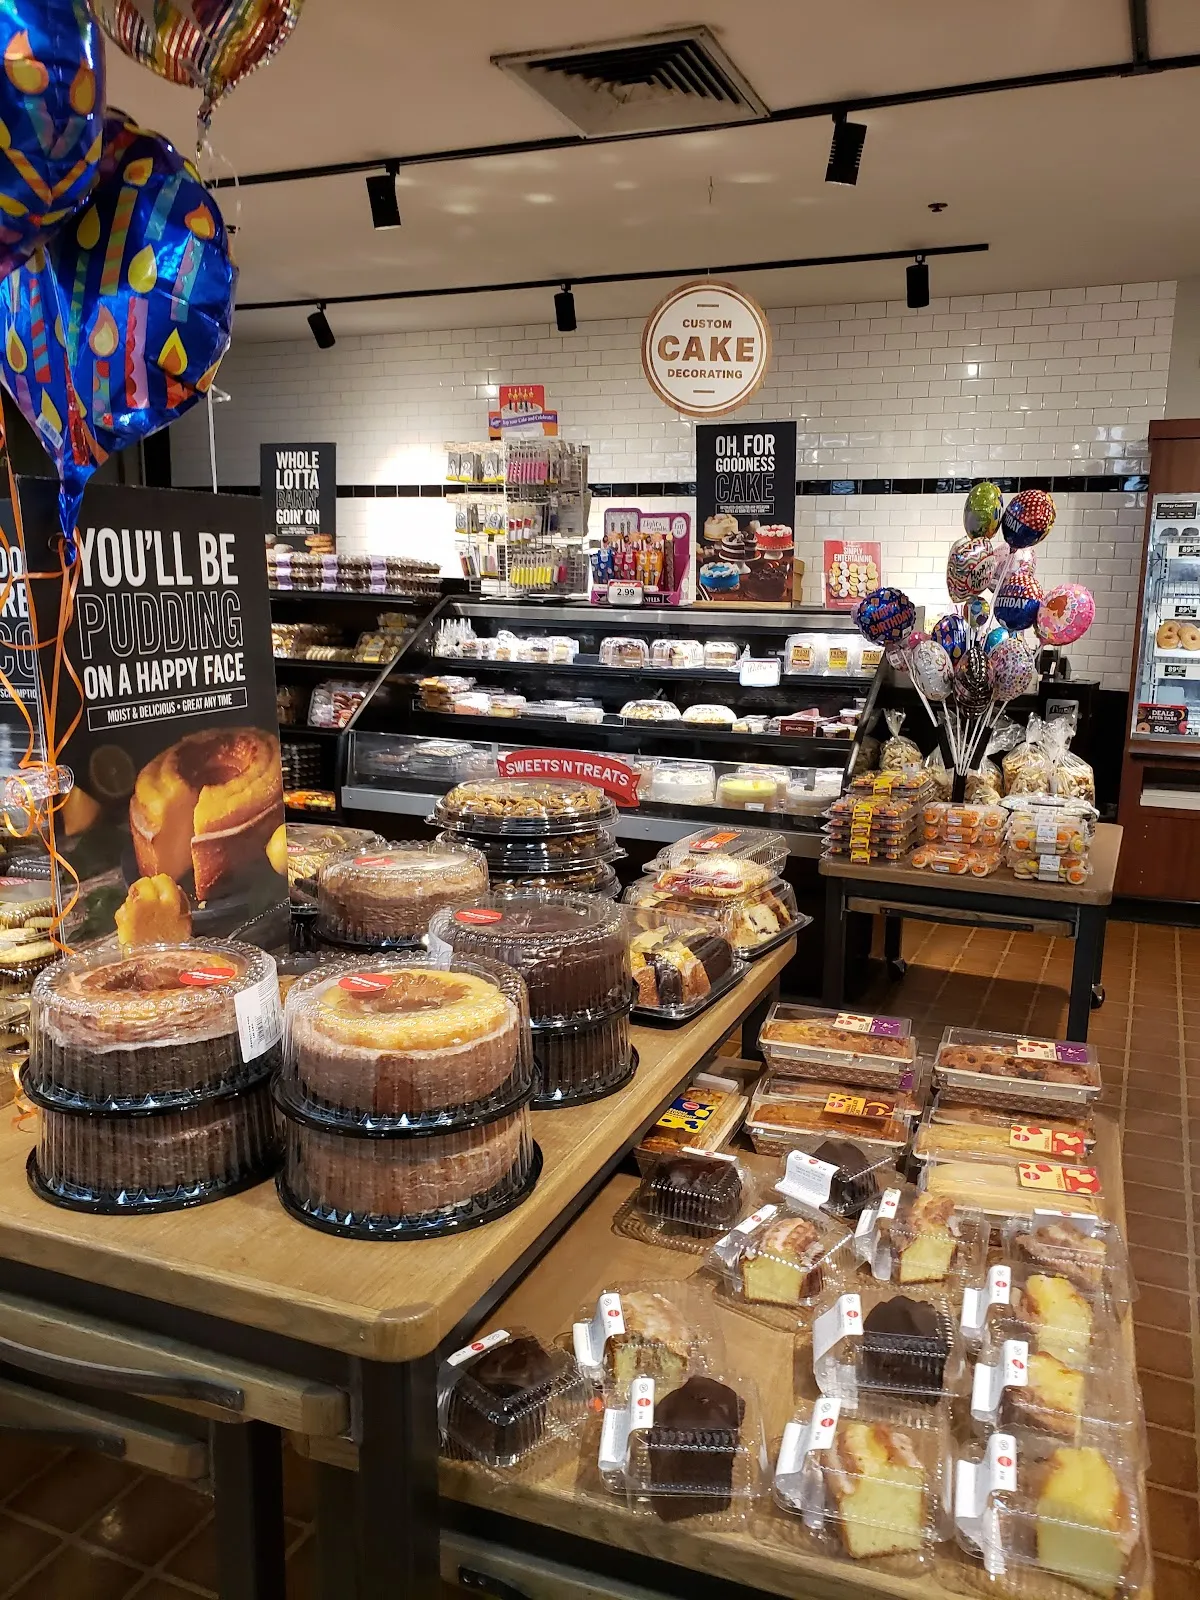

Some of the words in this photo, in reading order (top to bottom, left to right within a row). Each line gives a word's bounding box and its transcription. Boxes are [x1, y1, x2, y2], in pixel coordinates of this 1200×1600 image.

[682, 319, 732, 329] CUSTOM
[657, 335, 755, 362] CAKE
[667, 369, 743, 379] DECORATING
[715, 435, 740, 457] OH,
[743, 434, 776, 456] FOR
[275, 451, 320, 469] WHOLE
[715, 456, 776, 473] GOODNESS
[275, 469, 320, 490] LOTTA
[715, 472, 775, 503] CAKE
[275, 489, 320, 509] BAKIN'
[275, 509, 303, 525] GOIN'
[305, 509, 320, 525] ON
[79, 528, 194, 587] YOU'LL
[199, 532, 239, 585] BE
[833, 554, 873, 563] ENTERTAINING
[843, 546, 863, 555] SIMPLY
[616, 588, 635, 596] 2.99
[871, 600, 899, 621] HAPPY
[77, 590, 244, 660] PUDDING
[870, 608, 912, 635] BIRTHDAY
[84, 664, 114, 700] ON
[118, 663, 132, 696] A
[135, 656, 198, 694] HAPPY
[203, 652, 246, 685] FACE
[107, 709, 132, 723] MOIST
[132, 708, 139, 720] &
[139, 701, 176, 719] DELICIOUS
[182, 697, 203, 712] GREAT
[204, 695, 217, 709] ANY
[217, 693, 232, 707] TIME
[574, 761, 630, 786] TREATS
